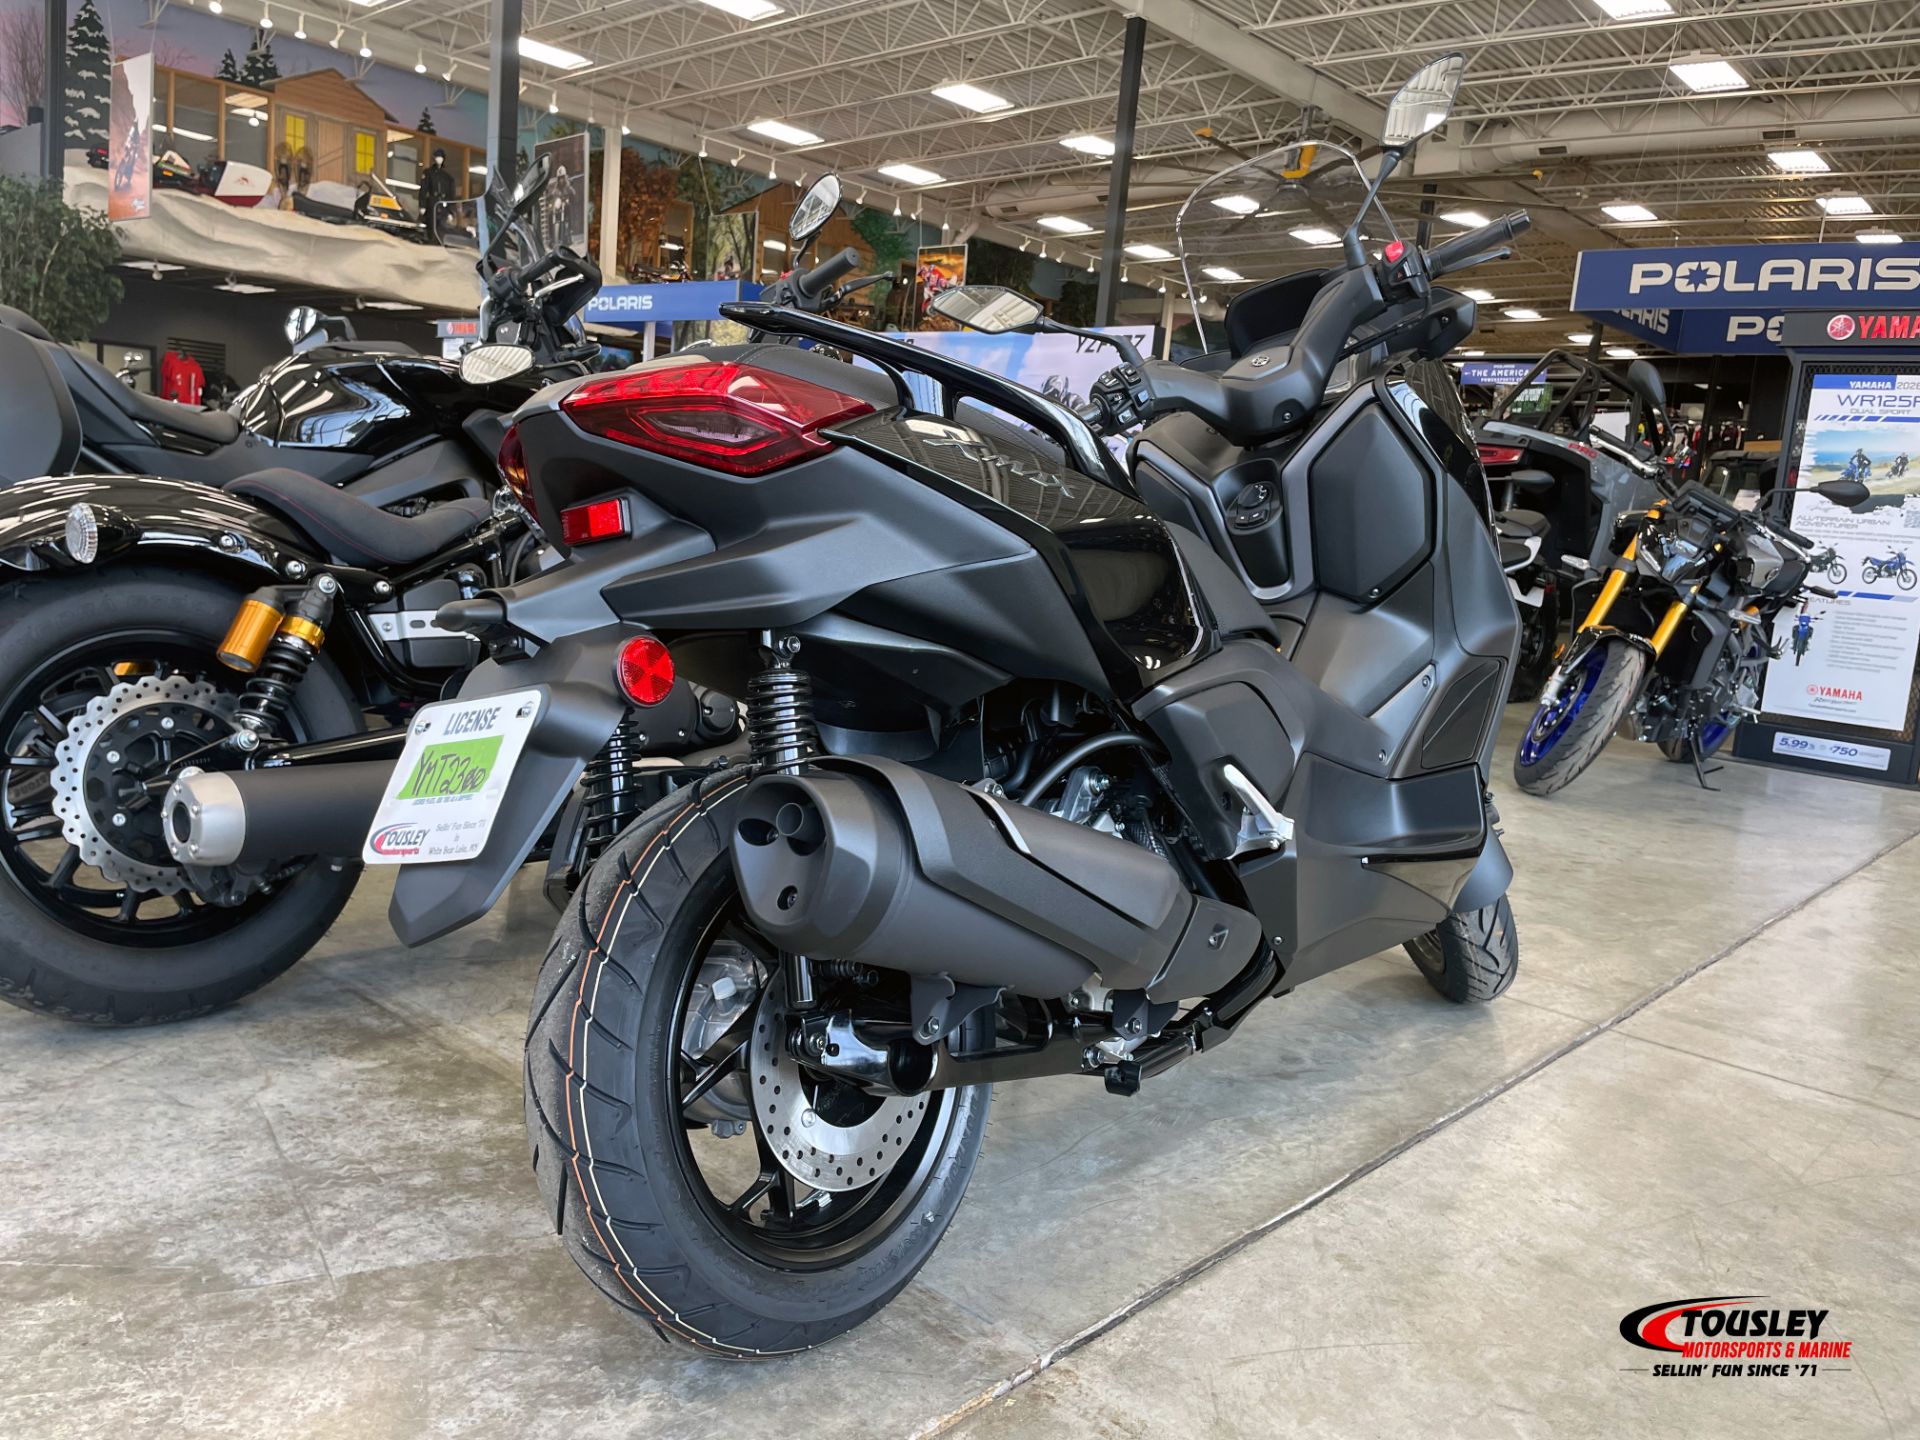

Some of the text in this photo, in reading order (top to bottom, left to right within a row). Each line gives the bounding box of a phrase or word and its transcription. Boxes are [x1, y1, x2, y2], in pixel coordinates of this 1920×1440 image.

[1629, 257, 1920, 294] POLARIS
[588, 295, 653, 311] POLARIS
[1471, 369, 1530, 377] THE AMERICA
[1849, 381, 1892, 389] YAMAHA
[1808, 596, 1851, 606] EATURES
[1820, 686, 1862, 700] YAMAHA
[443, 707, 501, 736] LICENSE
[383, 829, 430, 846] TOUSLEY
